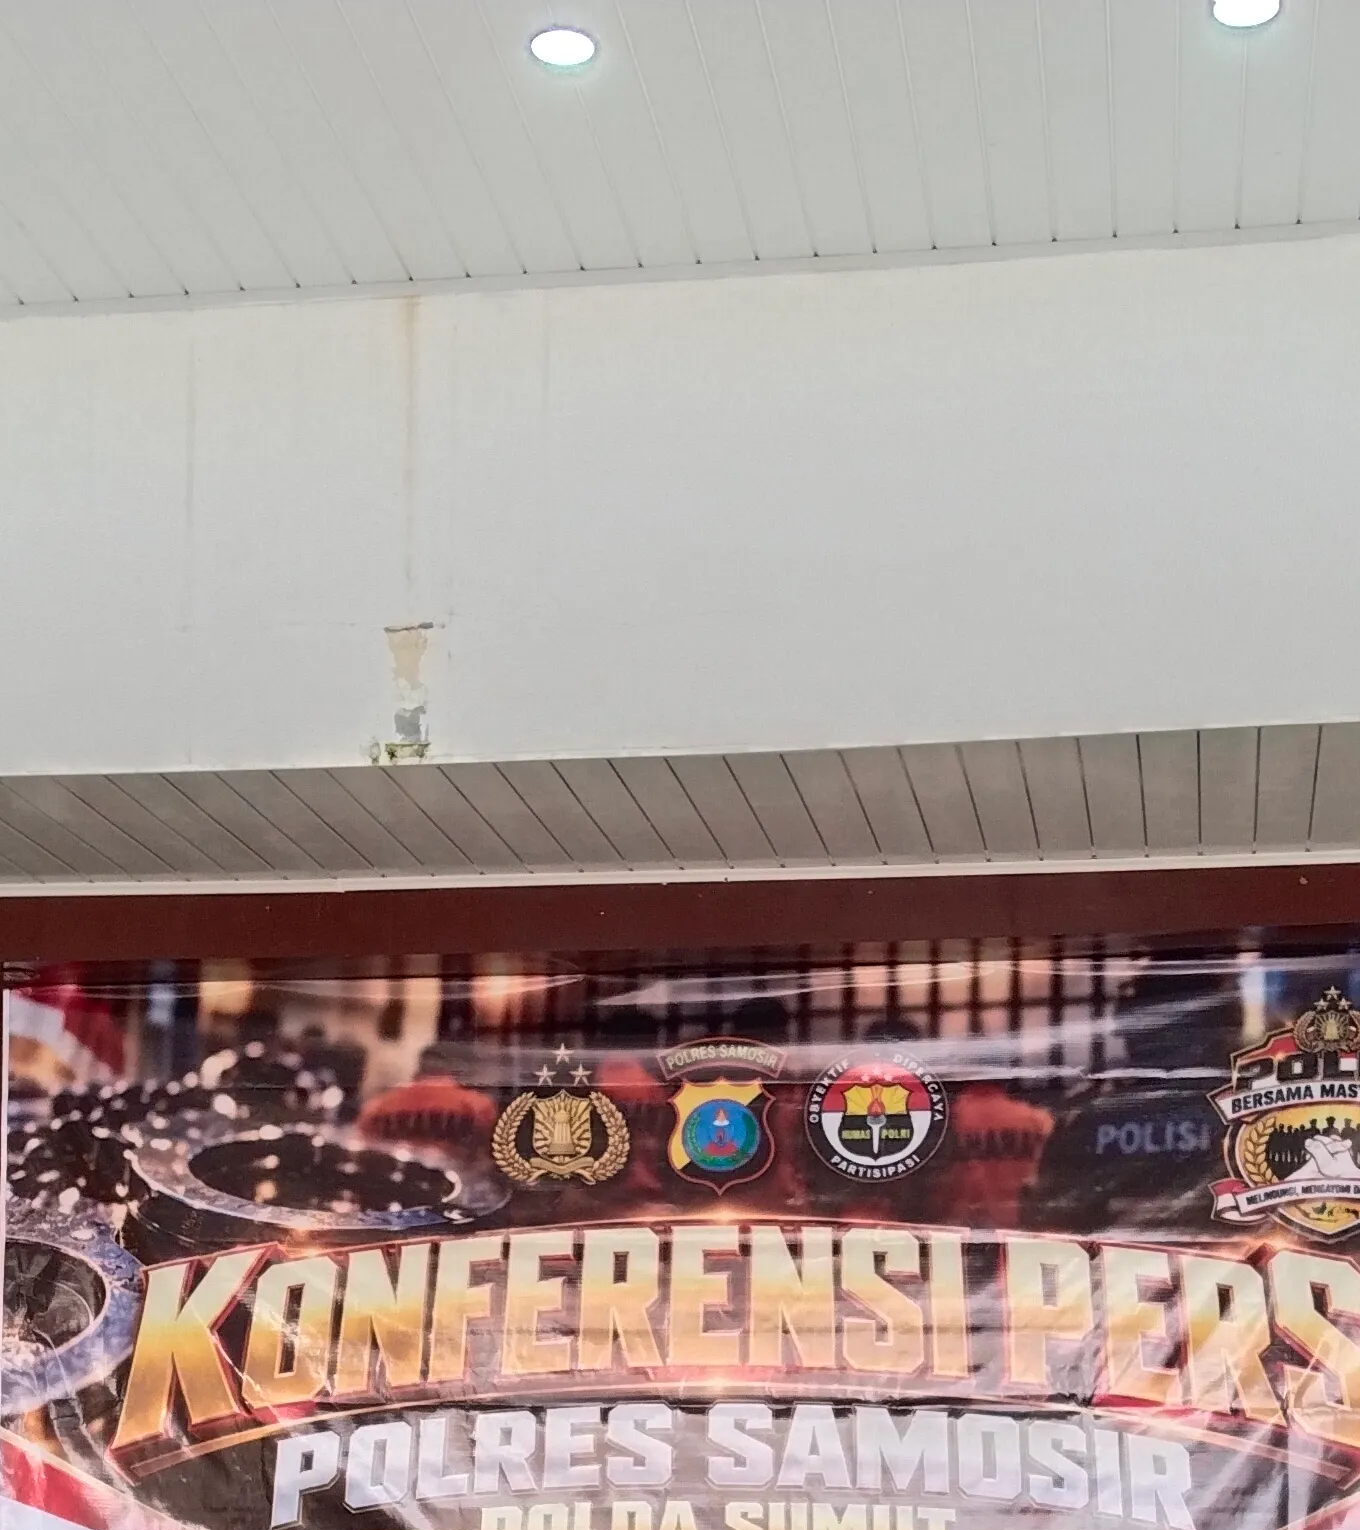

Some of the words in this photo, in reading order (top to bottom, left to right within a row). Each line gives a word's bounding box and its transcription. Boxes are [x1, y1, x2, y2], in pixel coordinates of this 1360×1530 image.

[665, 1045, 717, 1070] POLRES
[719, 1044, 778, 1069] SAMOSIR
[809, 1059, 849, 1124] OBYEKTIF
[1231, 1086, 1314, 1115] BERSAMA
[881, 1128, 911, 1140] POLRI
[1095, 1119, 1211, 1155] POLISI
[829, 1154, 921, 1178] PARTISIPASI
[110, 1222, 974, 1453] KONFERENSI
[270, 1401, 675, 1530] POLRES
